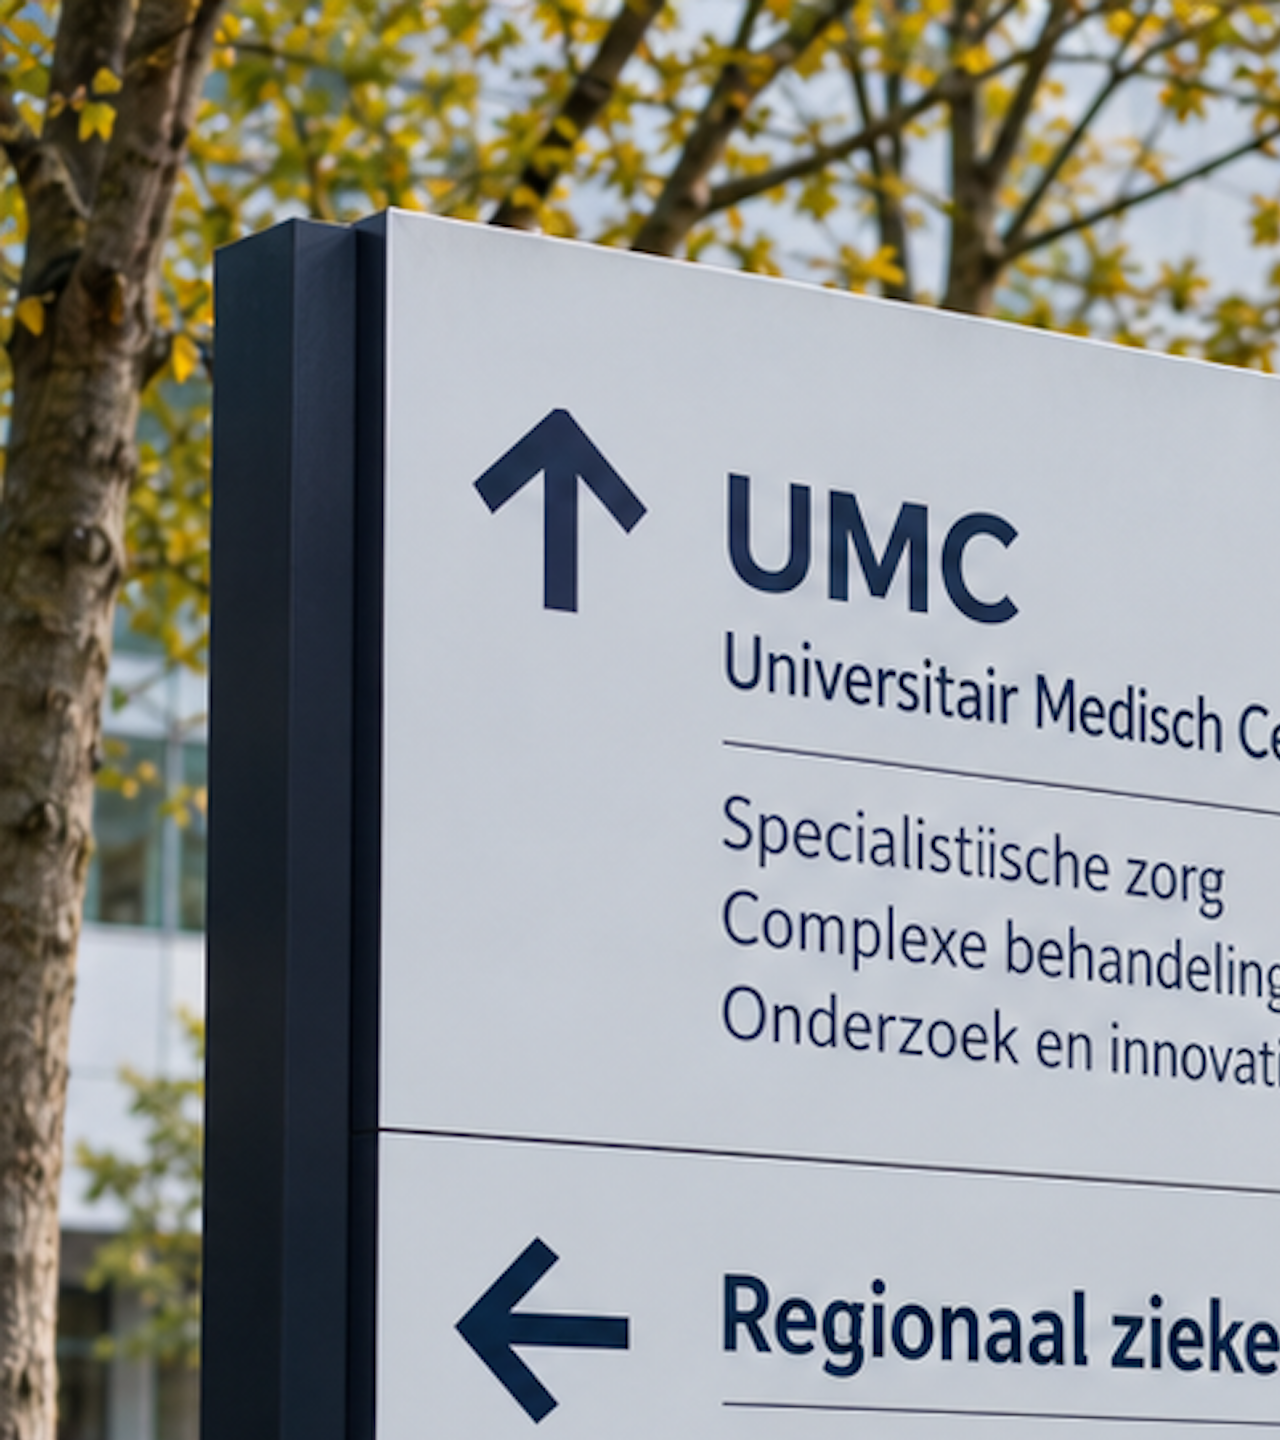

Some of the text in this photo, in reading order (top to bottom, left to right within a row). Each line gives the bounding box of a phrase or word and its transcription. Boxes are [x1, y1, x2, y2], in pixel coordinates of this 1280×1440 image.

[727, 472, 1020, 625] UMC
[725, 630, 1019, 725] Universitair
[1036, 673, 1223, 754] Medisch
[722, 795, 1225, 920] Specialistiische zorg
[722, 889, 987, 972] Complexe
[722, 984, 1019, 1065] Onderzoek
[1036, 1029, 1093, 1072] en
[723, 1273, 1089, 1379] Regionaal
